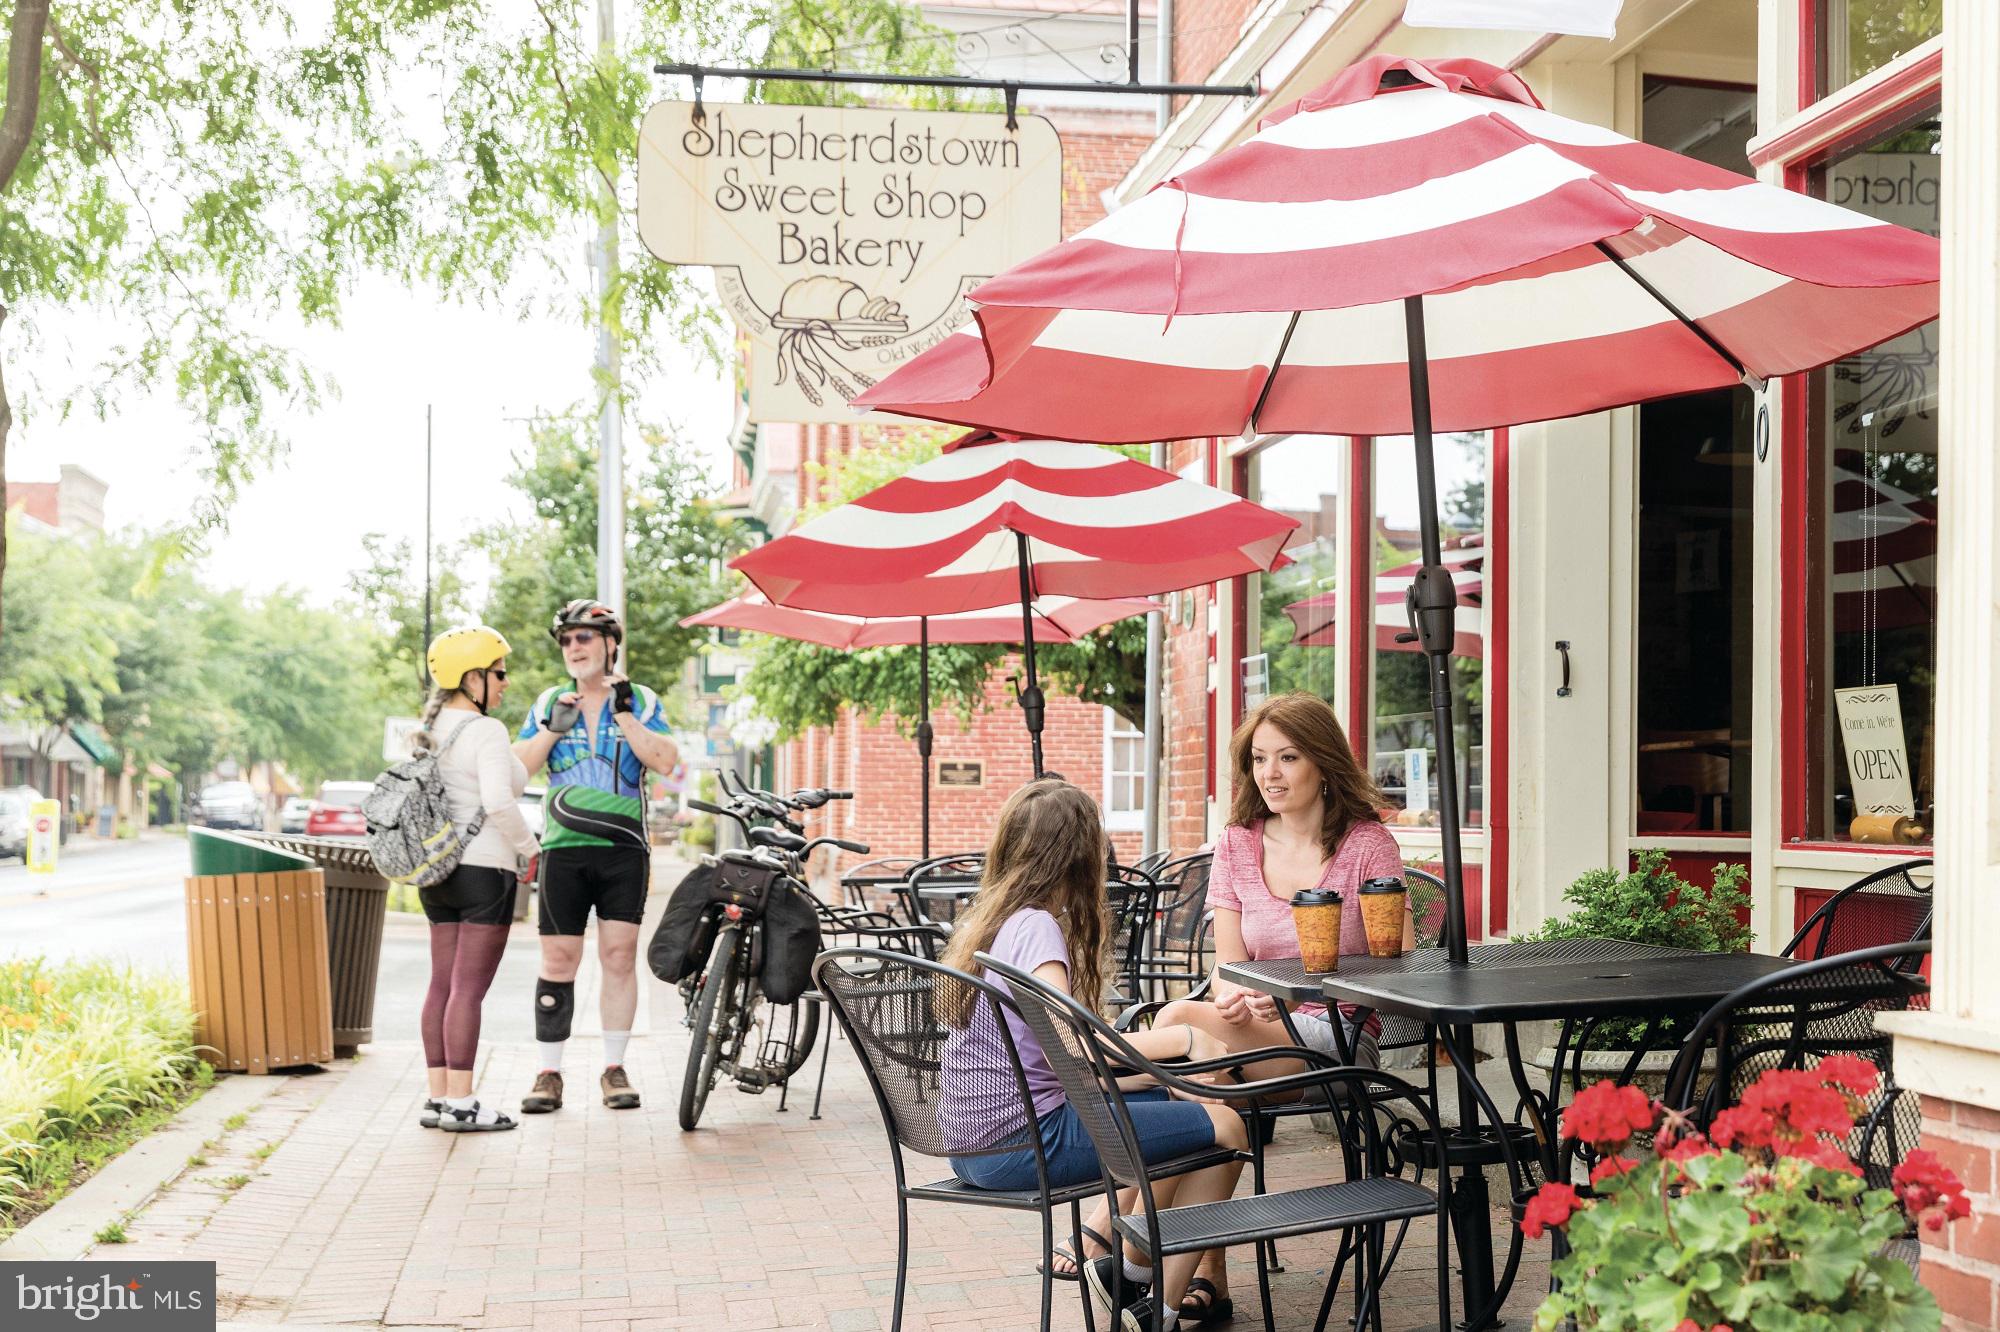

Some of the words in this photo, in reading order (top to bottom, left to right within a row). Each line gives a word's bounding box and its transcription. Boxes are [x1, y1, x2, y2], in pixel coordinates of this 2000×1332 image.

[682, 110, 1020, 176] Shepherdstown
[715, 166, 856, 217] Sweet
[874, 171, 986, 237] Shop
[778, 221, 924, 284] Bakery
[877, 345, 906, 364] Old
[1844, 717, 1865, 731] Come
[1853, 749, 1903, 781] OPEN
